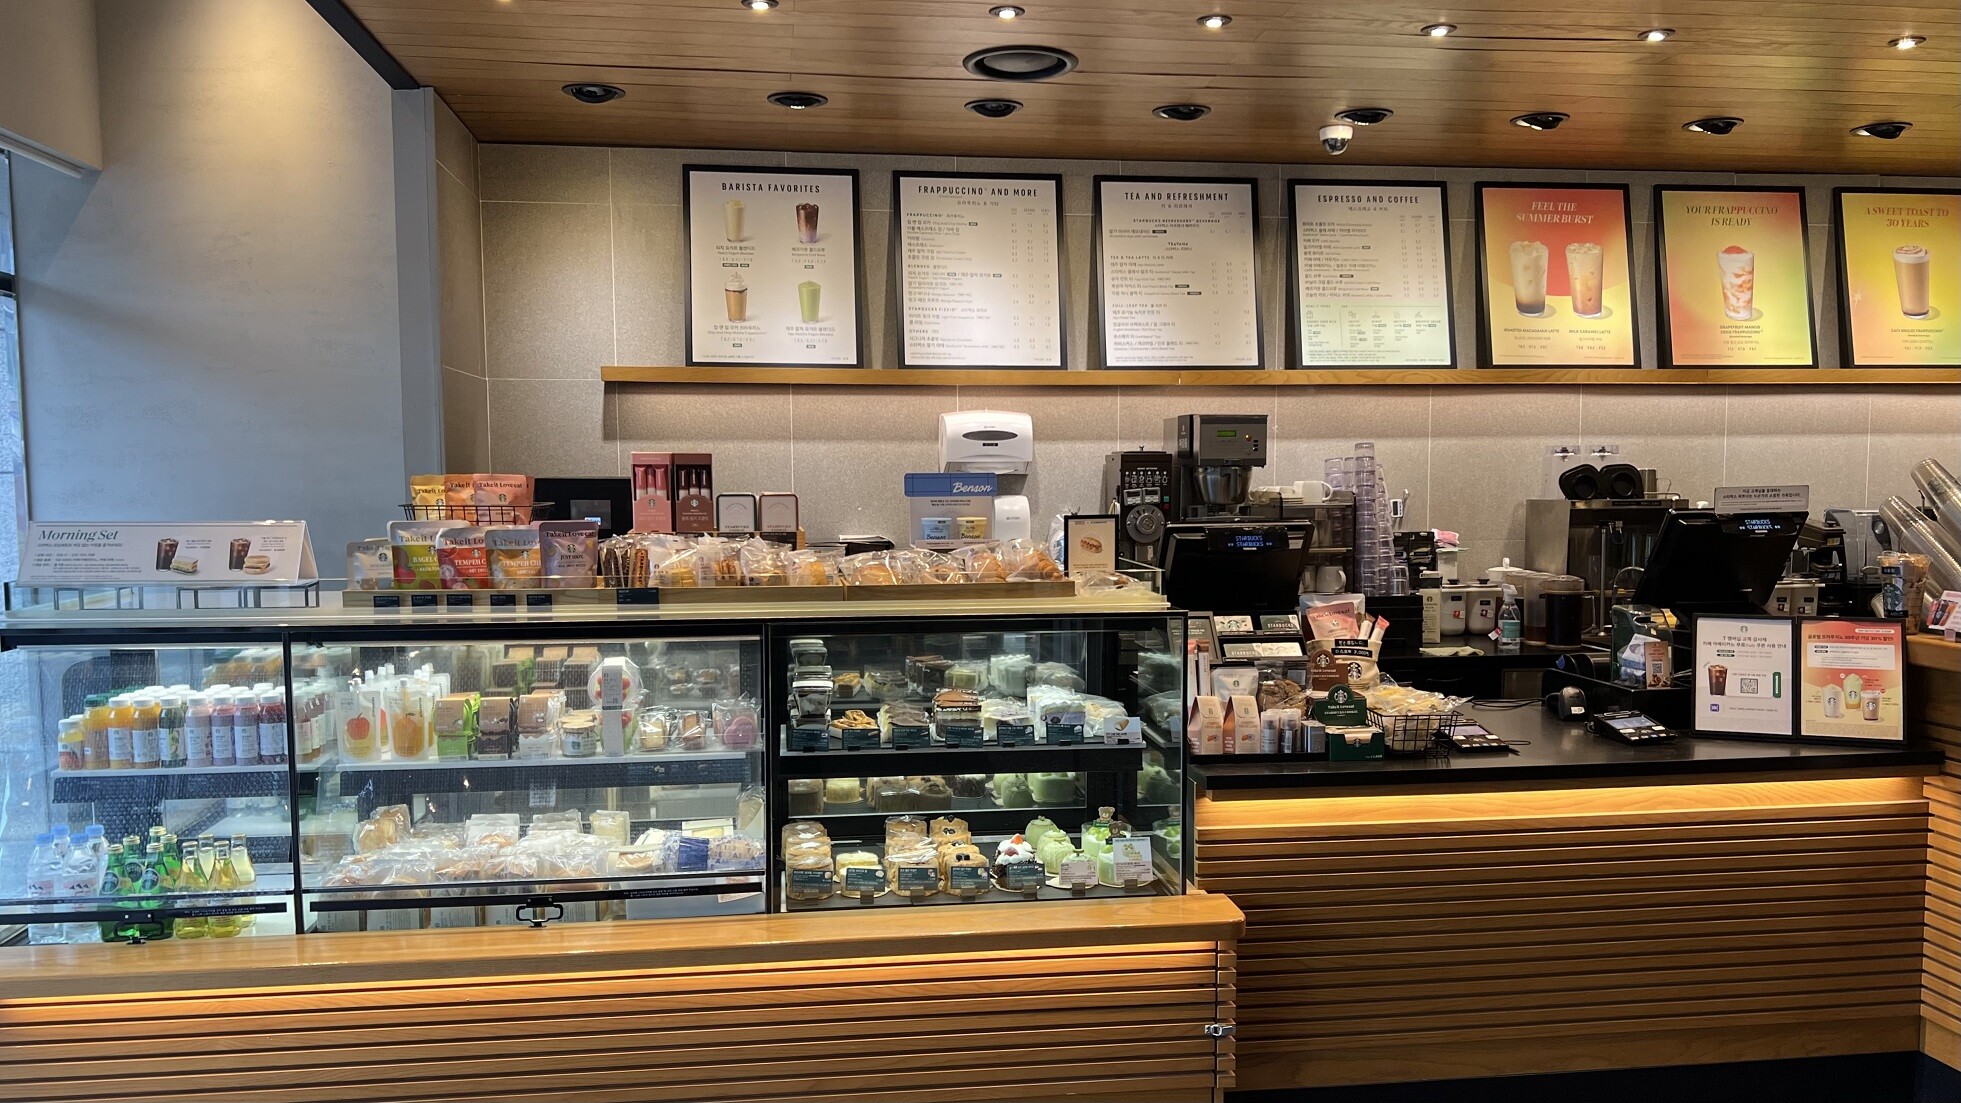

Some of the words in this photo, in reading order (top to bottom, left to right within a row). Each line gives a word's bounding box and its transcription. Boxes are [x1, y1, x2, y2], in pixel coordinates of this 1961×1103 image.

[722, 182, 763, 192] BARISTA
[768, 184, 820, 193] FAVORITES
[1124, 192, 1140, 200] TEA
[1144, 192, 1162, 201] AND
[1166, 193, 1229, 201] REFRESHMENT
[1318, 195, 1362, 203] ESPRESSO
[1366, 195, 1384, 203] AND
[1388, 196, 1419, 204] COFFEE
[1531, 202, 1555, 210] FEEL
[1557, 202, 1577, 211] THE
[1686, 206, 1712, 214] YOUR
[1712, 206, 1778, 215] FRAPPUCCINO
[1872, 207, 1903, 216] SWEET
[1906, 208, 1936, 216] TOAST
[1938, 209, 1949, 217] TO
[1516, 214, 1561, 223] SUMMER
[1562, 214, 1594, 224] BURST
[1711, 217, 1720, 226] IS
[1721, 217, 1752, 226] READY
[1886, 218, 1899, 227] 30
[1901, 219, 1929, 227] YEARS
[952, 482, 993, 493] Benson
[38, 529, 97, 542] Morning
[98, 530, 118, 540] Set
